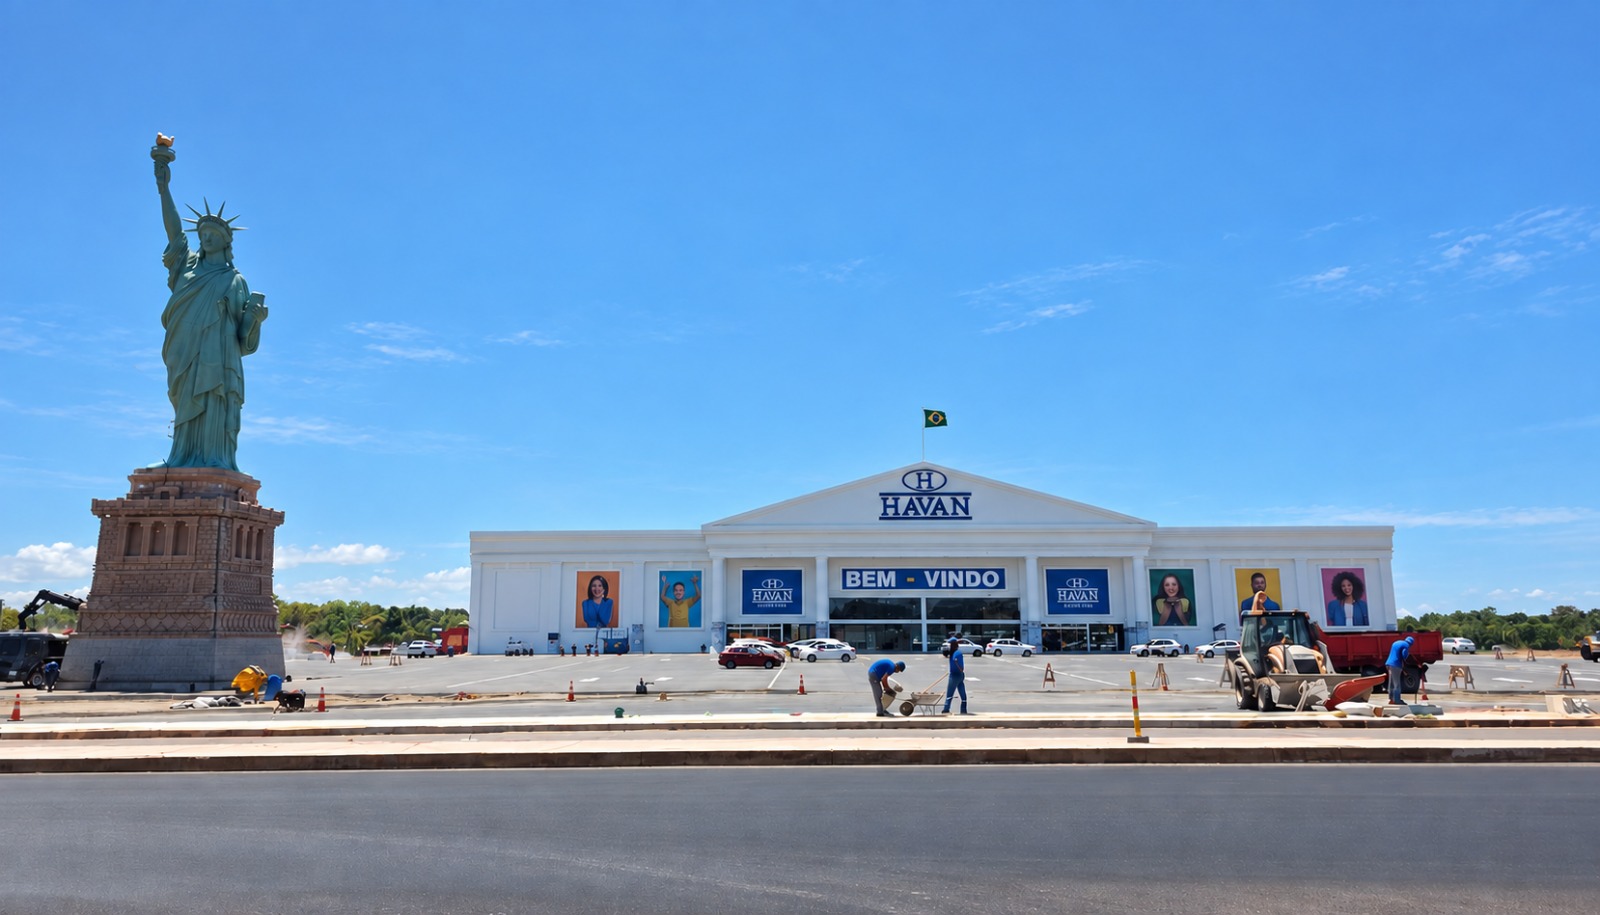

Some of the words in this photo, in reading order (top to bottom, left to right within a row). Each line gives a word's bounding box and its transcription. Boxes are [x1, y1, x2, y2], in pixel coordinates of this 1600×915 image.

[916, 472, 934, 489] H
[881, 496, 970, 516] HAVAN
[846, 570, 896, 587] BEM
[924, 570, 1000, 587] VINDO
[753, 591, 792, 600] HAVAN
[1058, 590, 1098, 600] HAVAN
